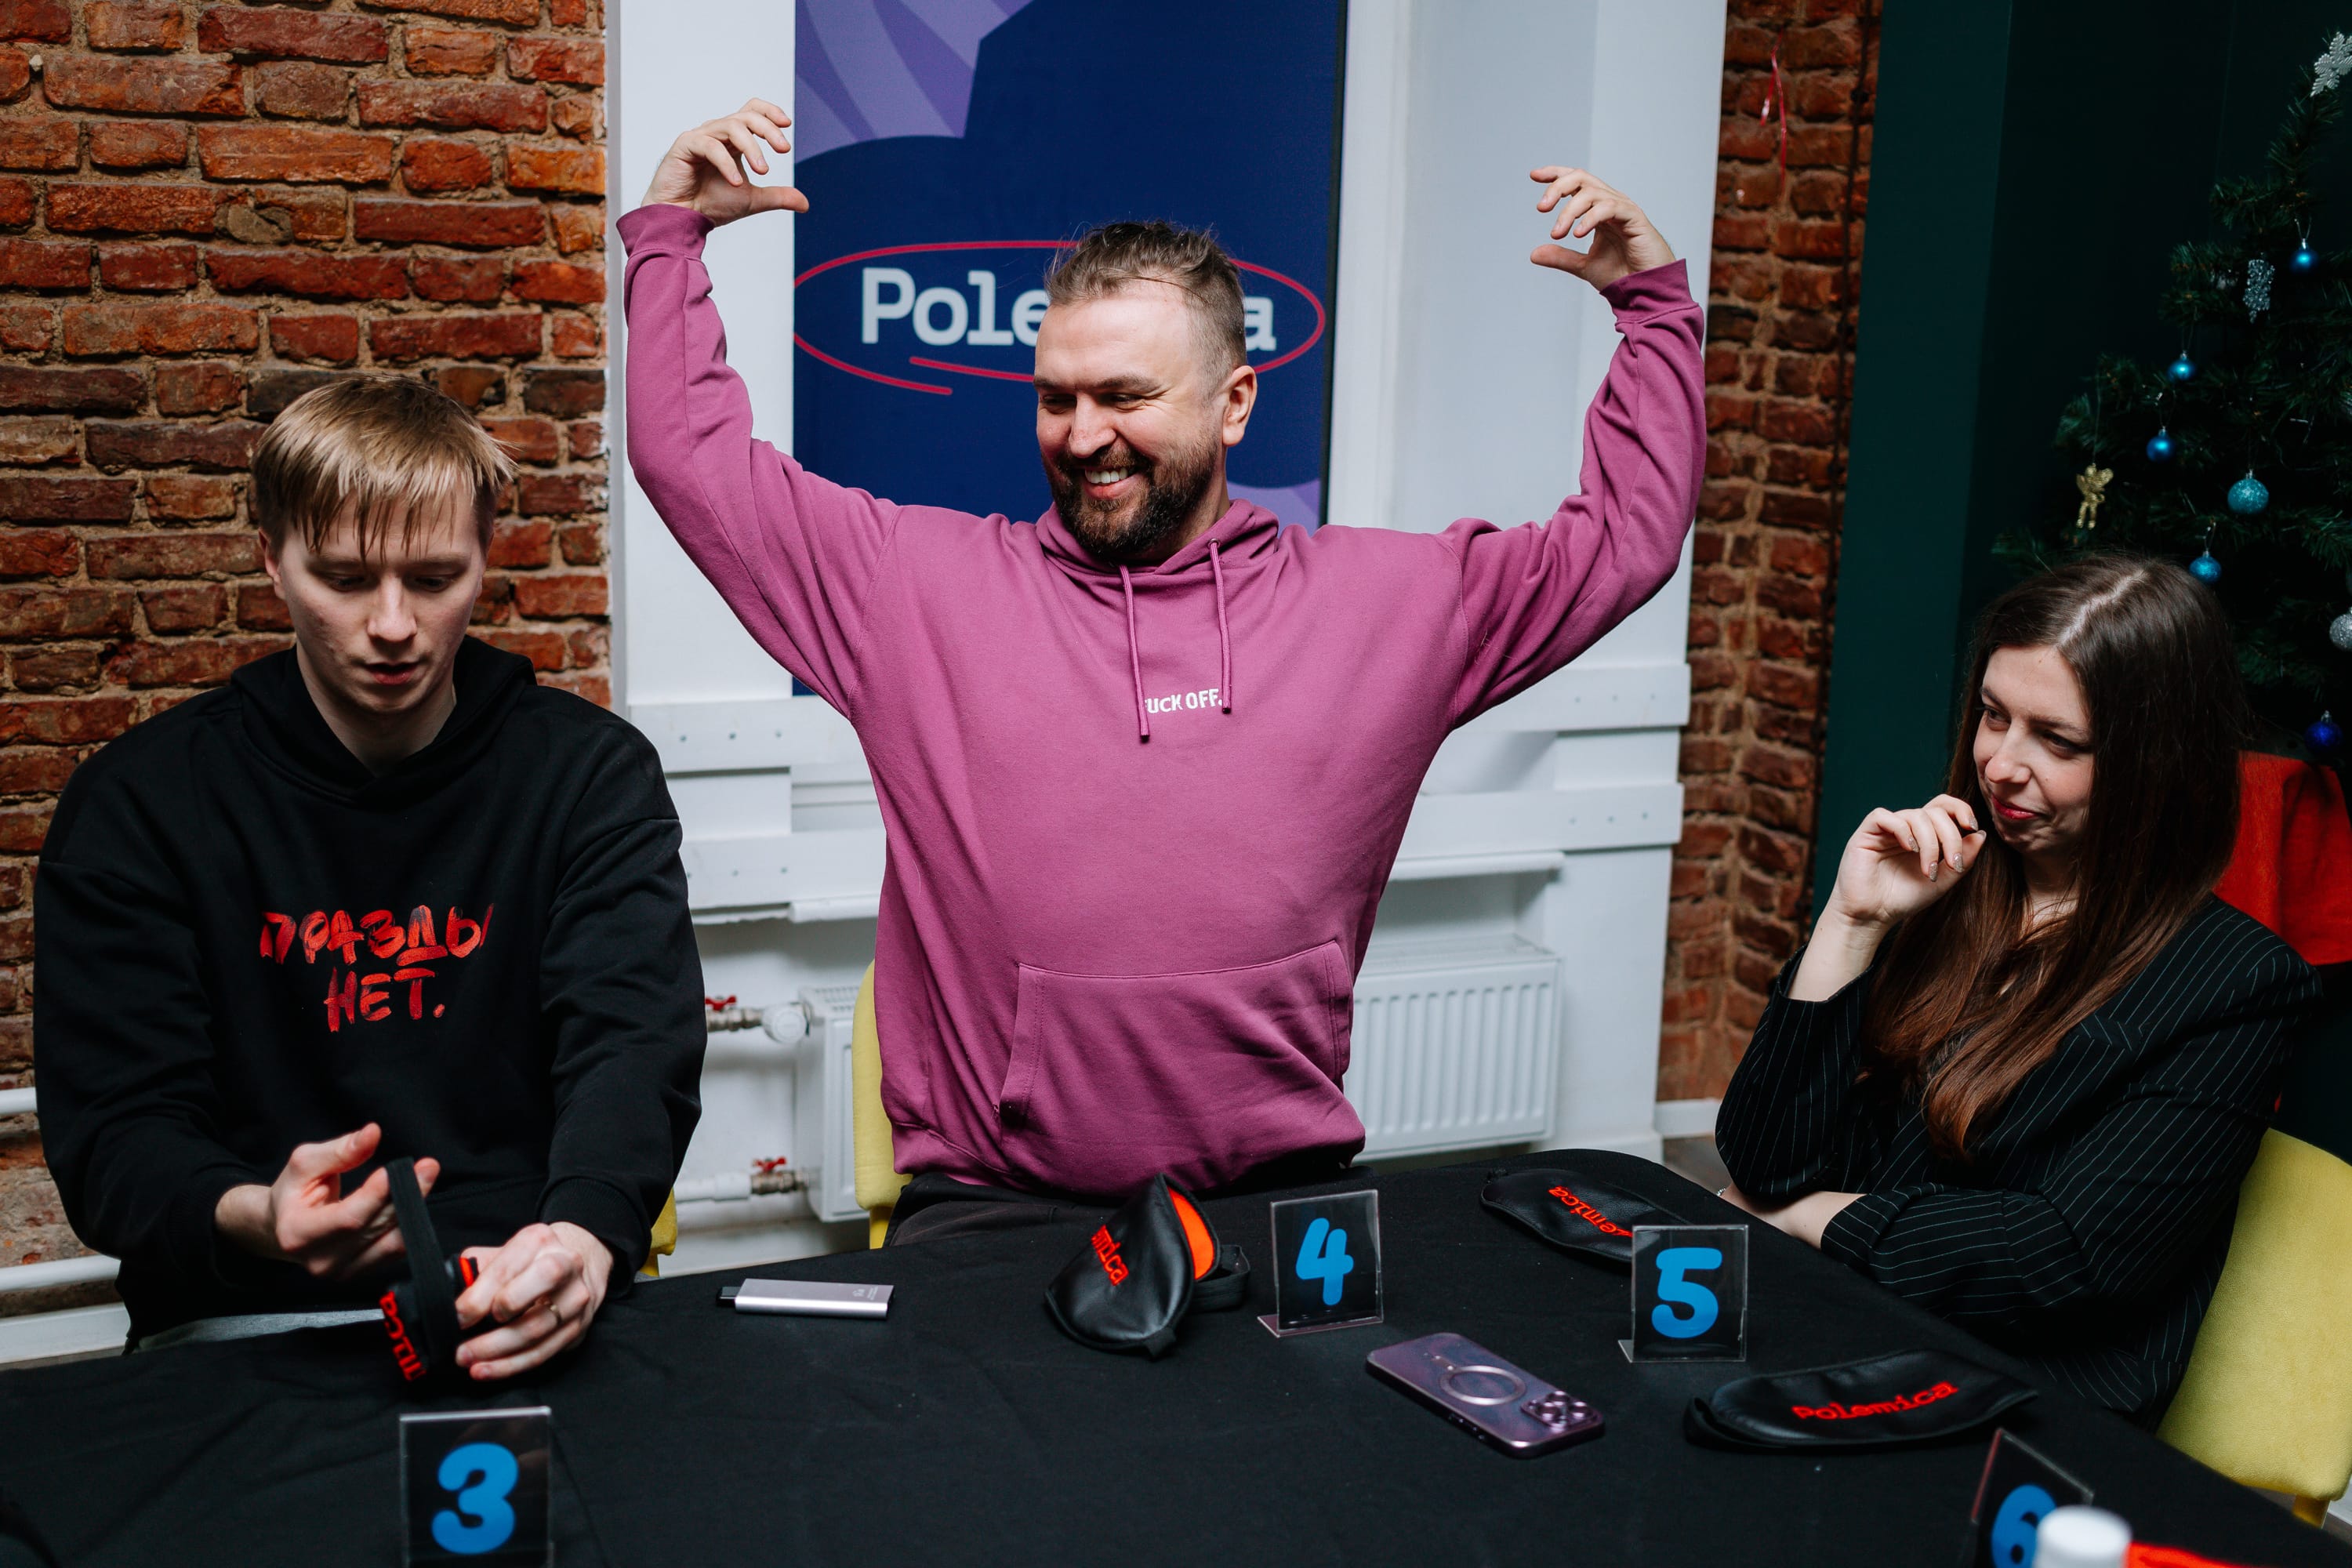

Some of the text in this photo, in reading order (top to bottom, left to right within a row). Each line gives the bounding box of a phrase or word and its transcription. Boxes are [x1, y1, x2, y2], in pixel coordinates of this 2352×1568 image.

[862, 267, 1276, 351] Polea
[1144, 694, 1183, 714] UCK
[322, 966, 445, 1033] НЕТ.
[1547, 1184, 1633, 1238] lemica
[1091, 1224, 1130, 1287] mica
[1296, 1218, 1354, 1305] 4
[1651, 1247, 1722, 1338] 5
[1791, 1381, 1958, 1420] Polemica
[430, 1442, 519, 1555] 3
